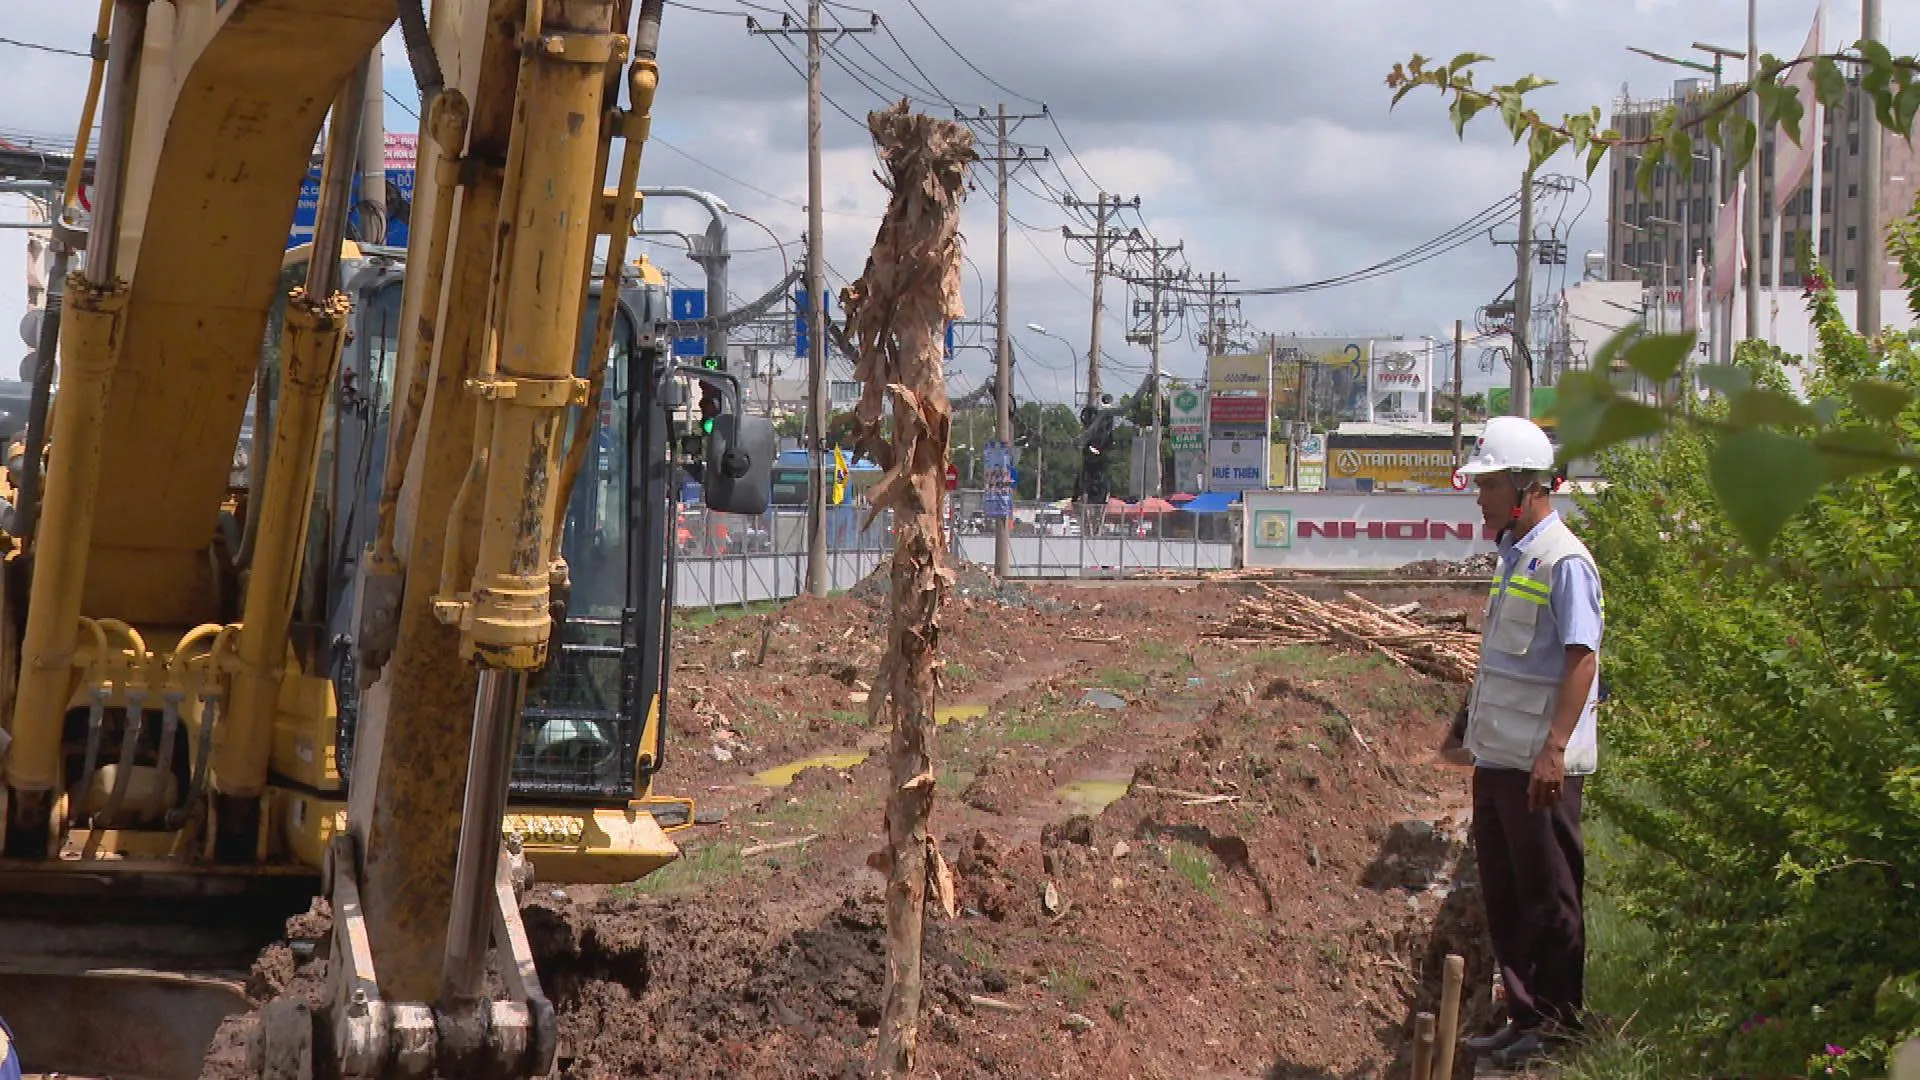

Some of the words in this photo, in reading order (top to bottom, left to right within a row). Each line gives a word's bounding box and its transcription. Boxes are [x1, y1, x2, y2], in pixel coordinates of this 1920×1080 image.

[1378, 374, 1421, 385] TOYOTA
[1400, 453, 1428, 467] ANH
[1297, 517, 1474, 540] NHƠN
